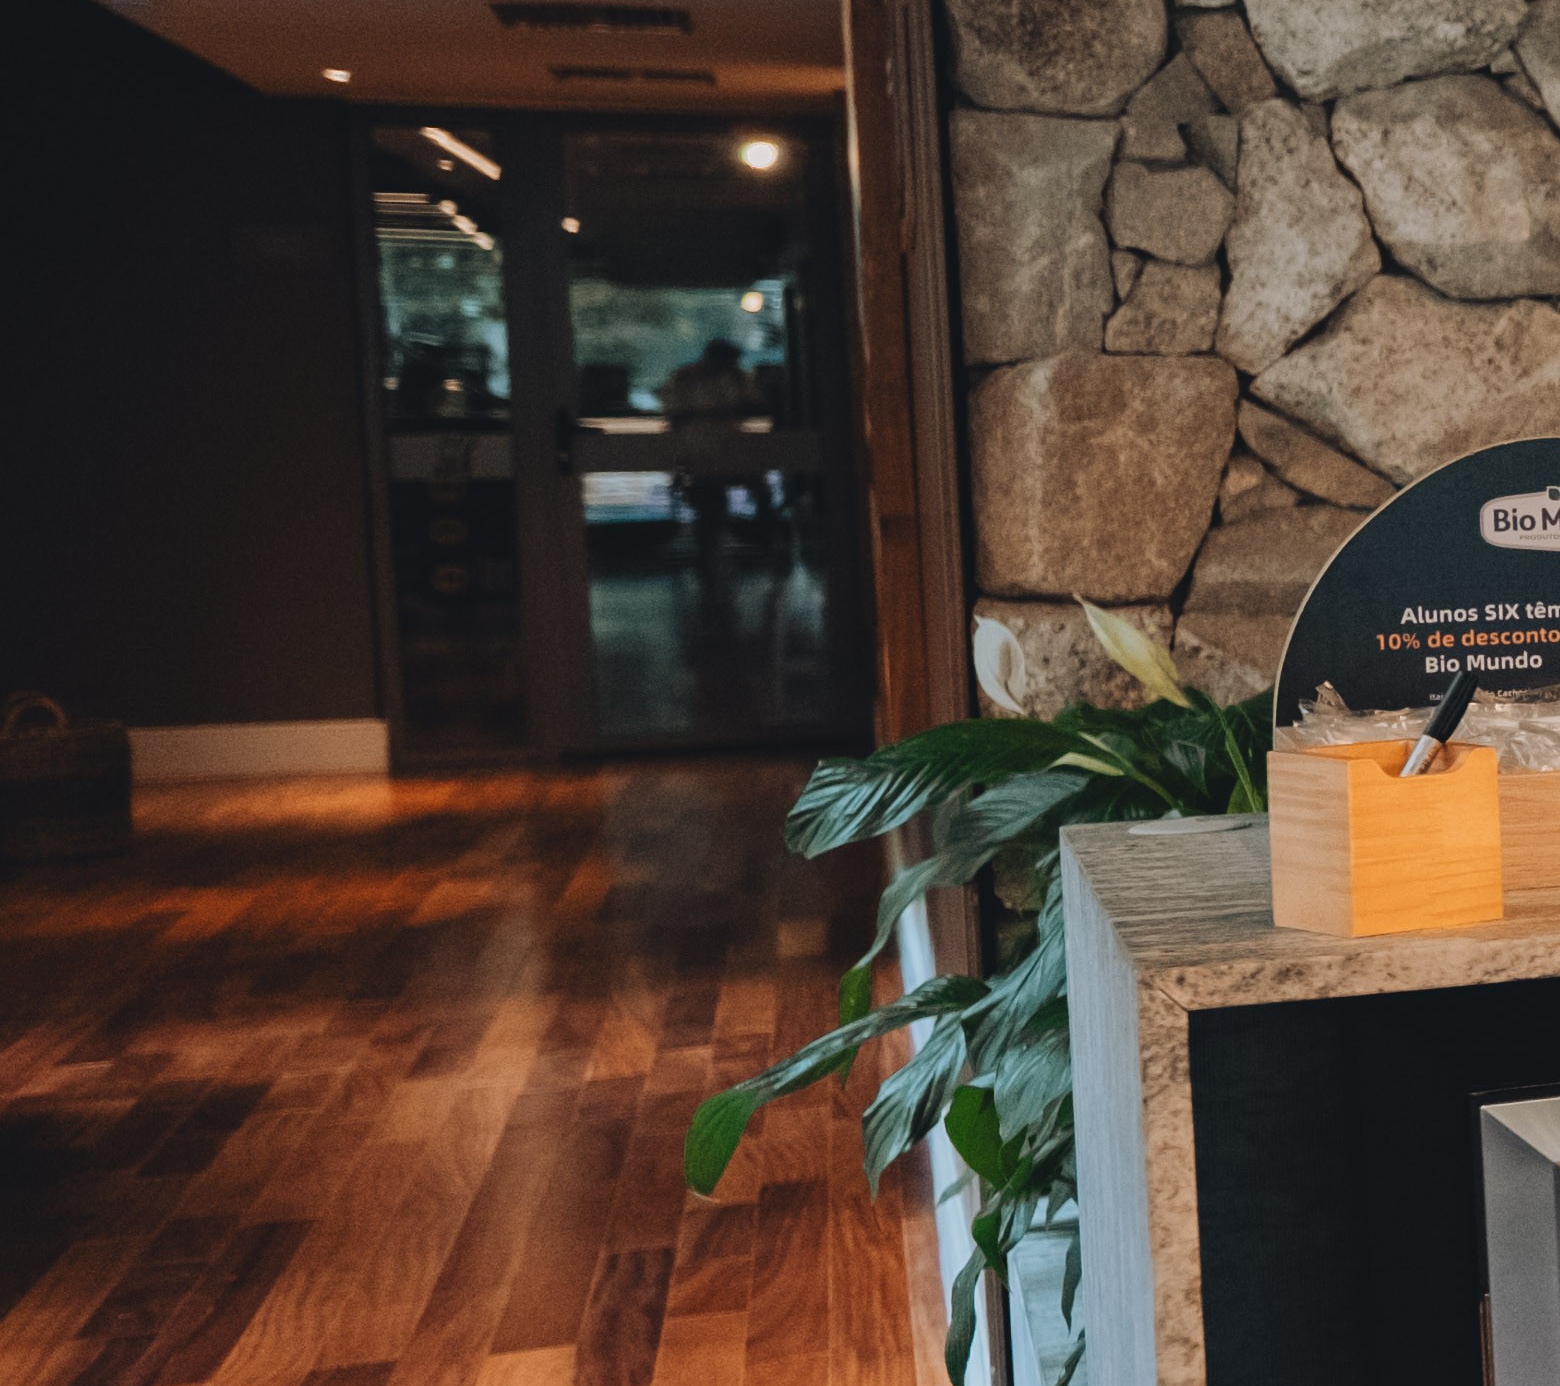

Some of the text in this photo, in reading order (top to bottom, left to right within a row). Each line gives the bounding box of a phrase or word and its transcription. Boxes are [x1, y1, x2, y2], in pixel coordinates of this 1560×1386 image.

[1493, 508, 1537, 532] Bio
[1400, 605, 1478, 625] Alunos
[1485, 603, 1520, 621] SIX
[1376, 633, 1421, 651] 10%
[1427, 629, 1455, 648] de
[1461, 627, 1560, 647] desconto
[1425, 650, 1543, 674] Bio Mundo
